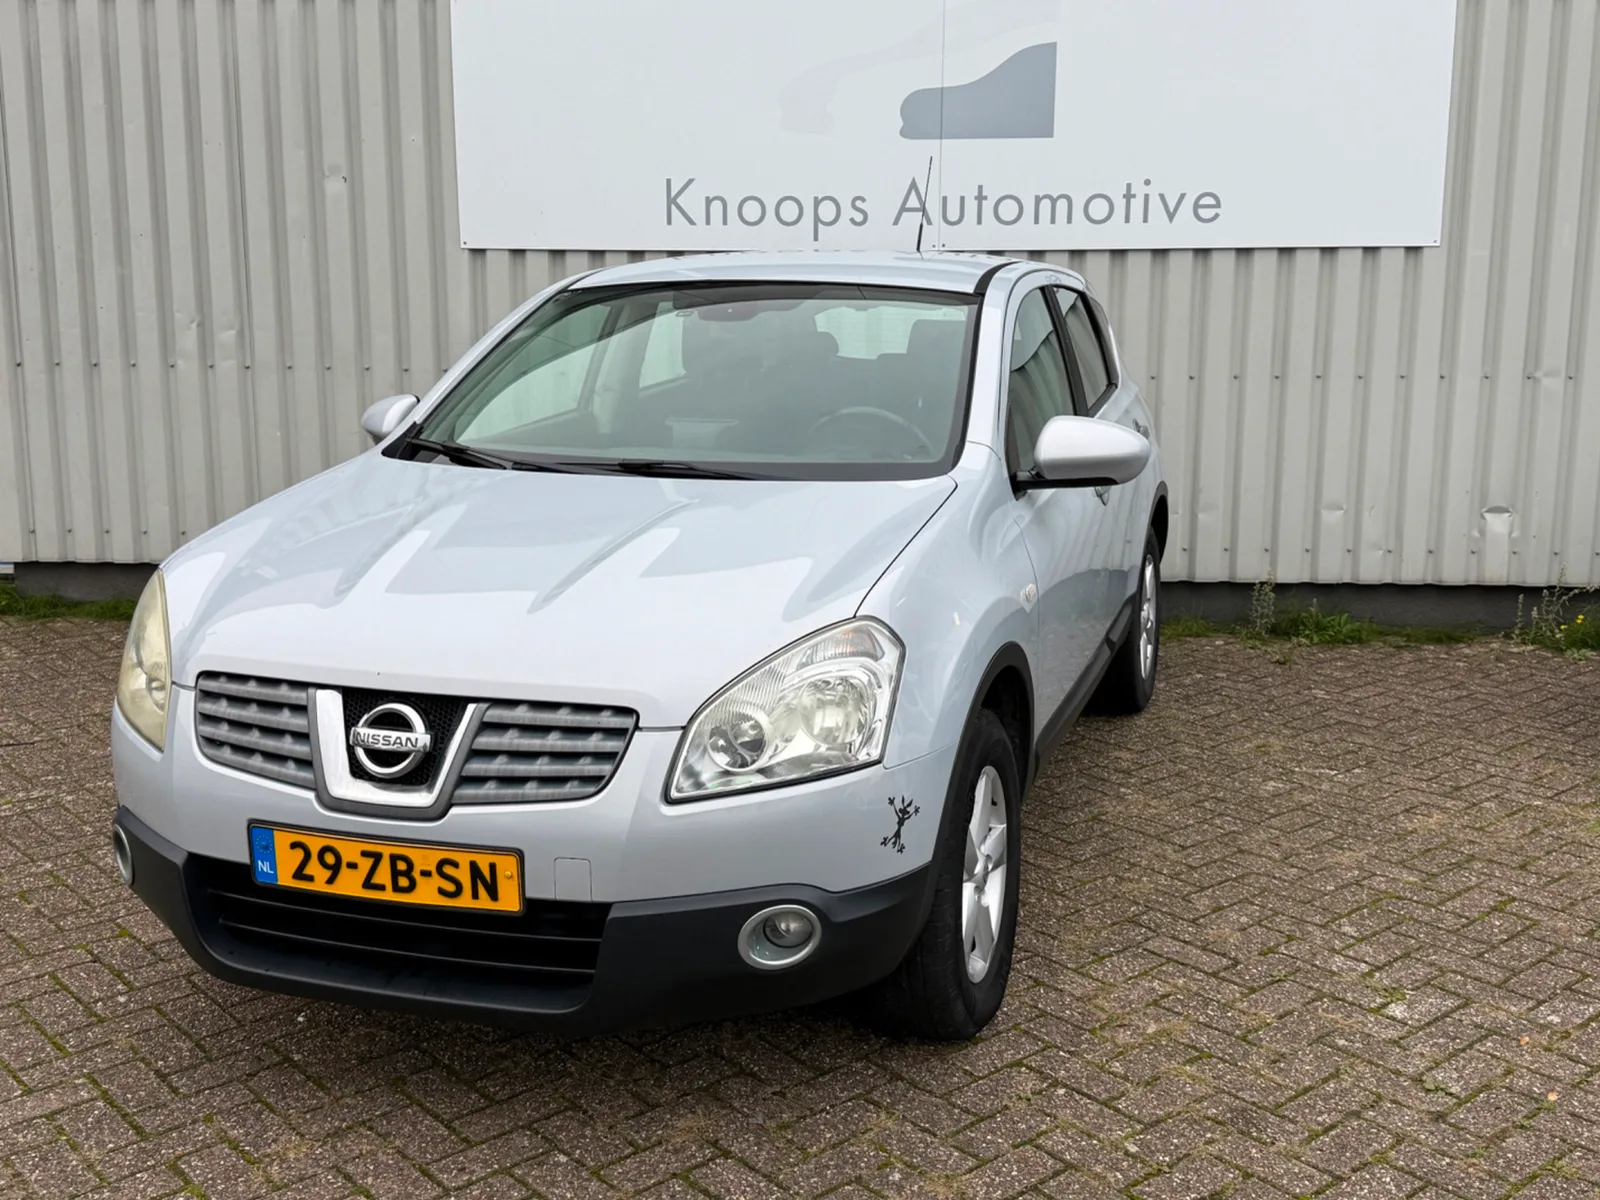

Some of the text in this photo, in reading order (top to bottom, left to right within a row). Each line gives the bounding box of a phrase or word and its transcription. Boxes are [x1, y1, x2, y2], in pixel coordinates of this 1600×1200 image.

[665, 177, 1222, 241] Knoops Automotive
[355, 731, 419, 748] NISSAN
[257, 860, 275, 874] NL
[289, 840, 499, 902] 29-ZB-SN
